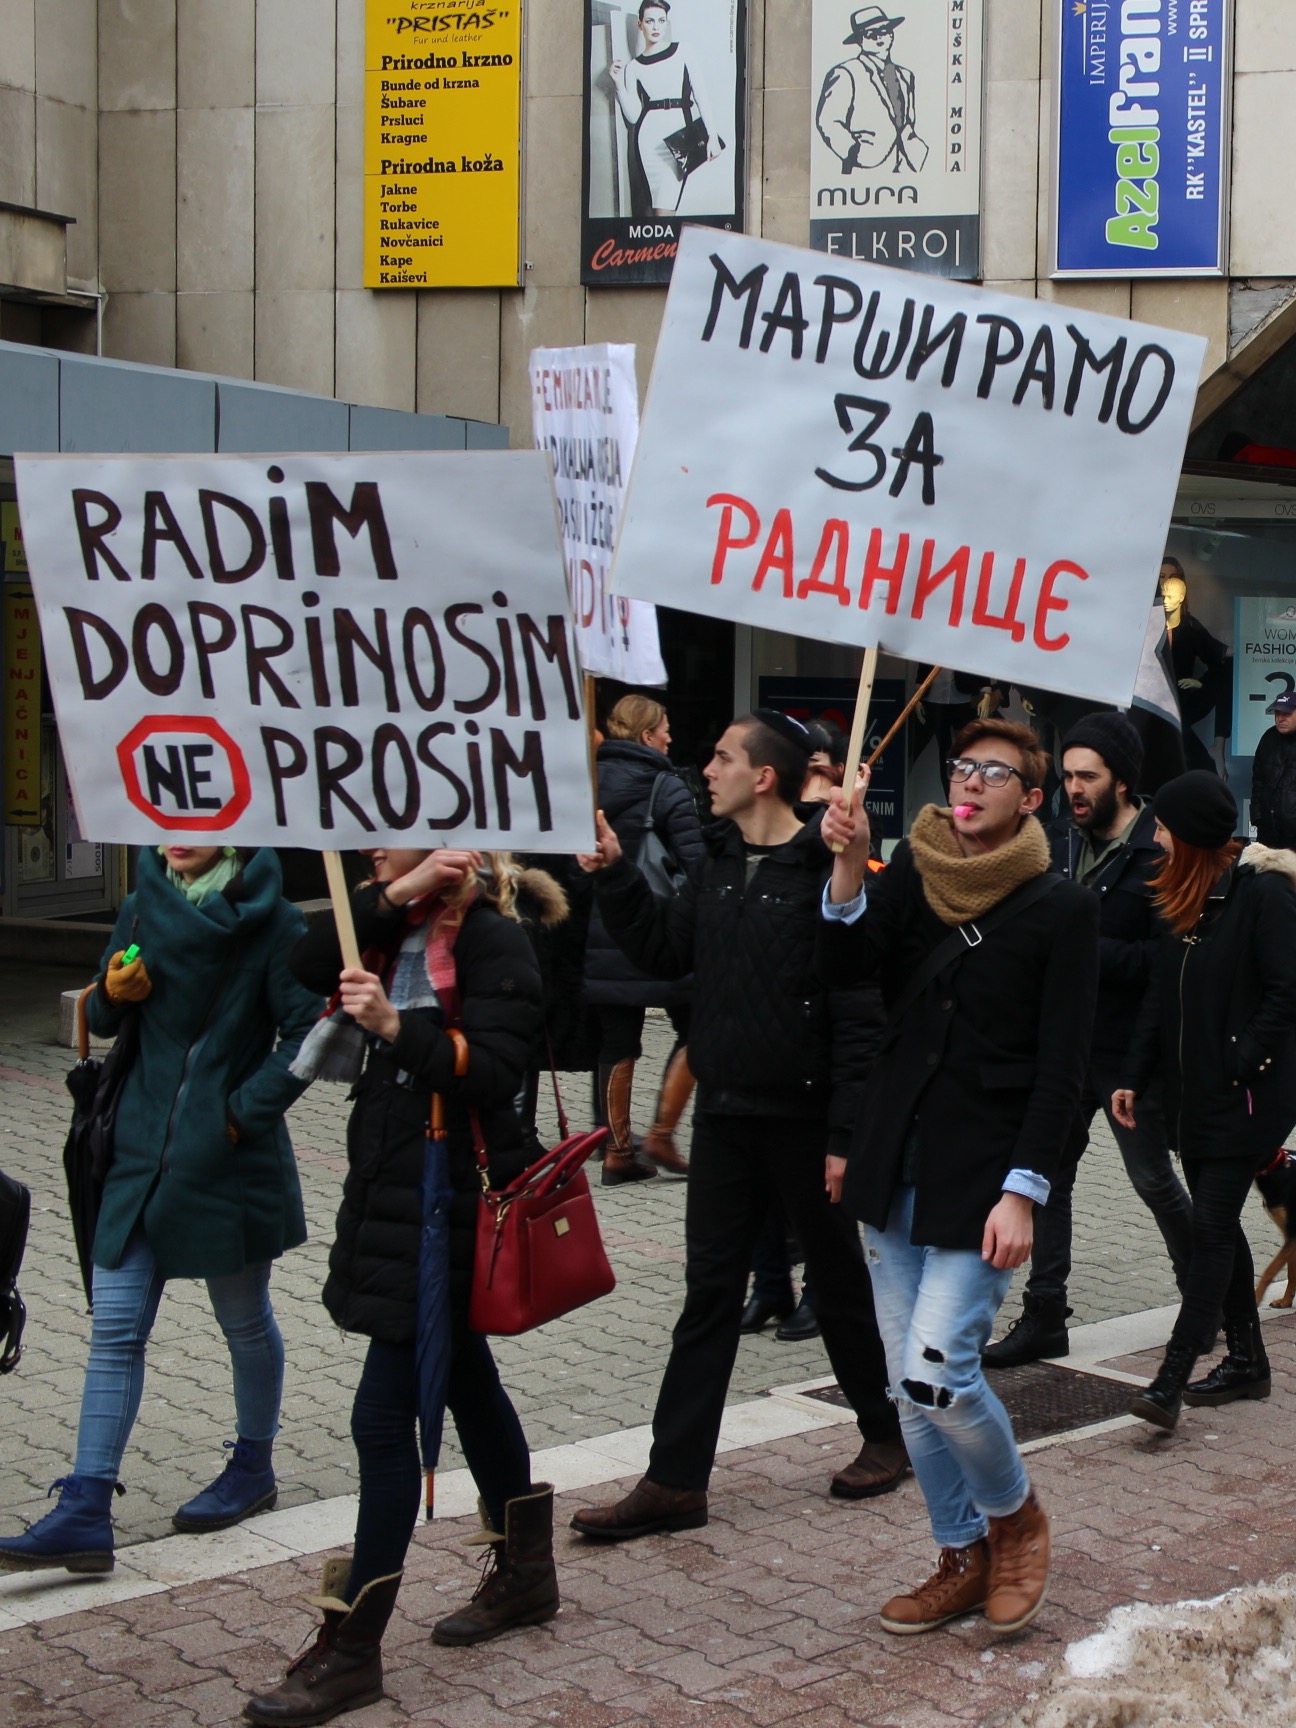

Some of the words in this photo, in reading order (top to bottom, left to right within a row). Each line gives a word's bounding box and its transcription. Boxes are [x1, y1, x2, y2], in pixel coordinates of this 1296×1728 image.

[410, 0, 486, 10] krznarija
[413, 37, 429, 45] Fur
[431, 34, 448, 44] und
[451, 33, 483, 43] leather
[381, 53, 458, 70] Prirodno
[462, 51, 513, 67] krzno
[381, 79, 421, 91] Bunde
[424, 79, 439, 90] od
[443, 78, 480, 89] krzna
[381, 93, 426, 109] Šubare
[380, 115, 424, 127] Prsluci
[380, 132, 428, 146] Kragne
[949, 106, 963, 173] MODA
[381, 157, 457, 175] Prirodna
[461, 153, 504, 172] koža
[381, 184, 417, 198] Jakne
[380, 201, 417, 213] Torbe
[380, 218, 439, 230] Rukavice
[629, 225, 674, 238] MODA
[380, 234, 443, 247] Novčanici
[380, 255, 413, 268] Kape
[591, 239, 678, 271] Carmen
[380, 270, 427, 283] Kaiševi
[700, 253, 1176, 434] МАРШИРАМО
[814, 392, 943, 505] ЗА
[1190, 502, 1217, 515] OVS
[142, 743, 222, 810] NE
[865, 801, 895, 816] ENIM
